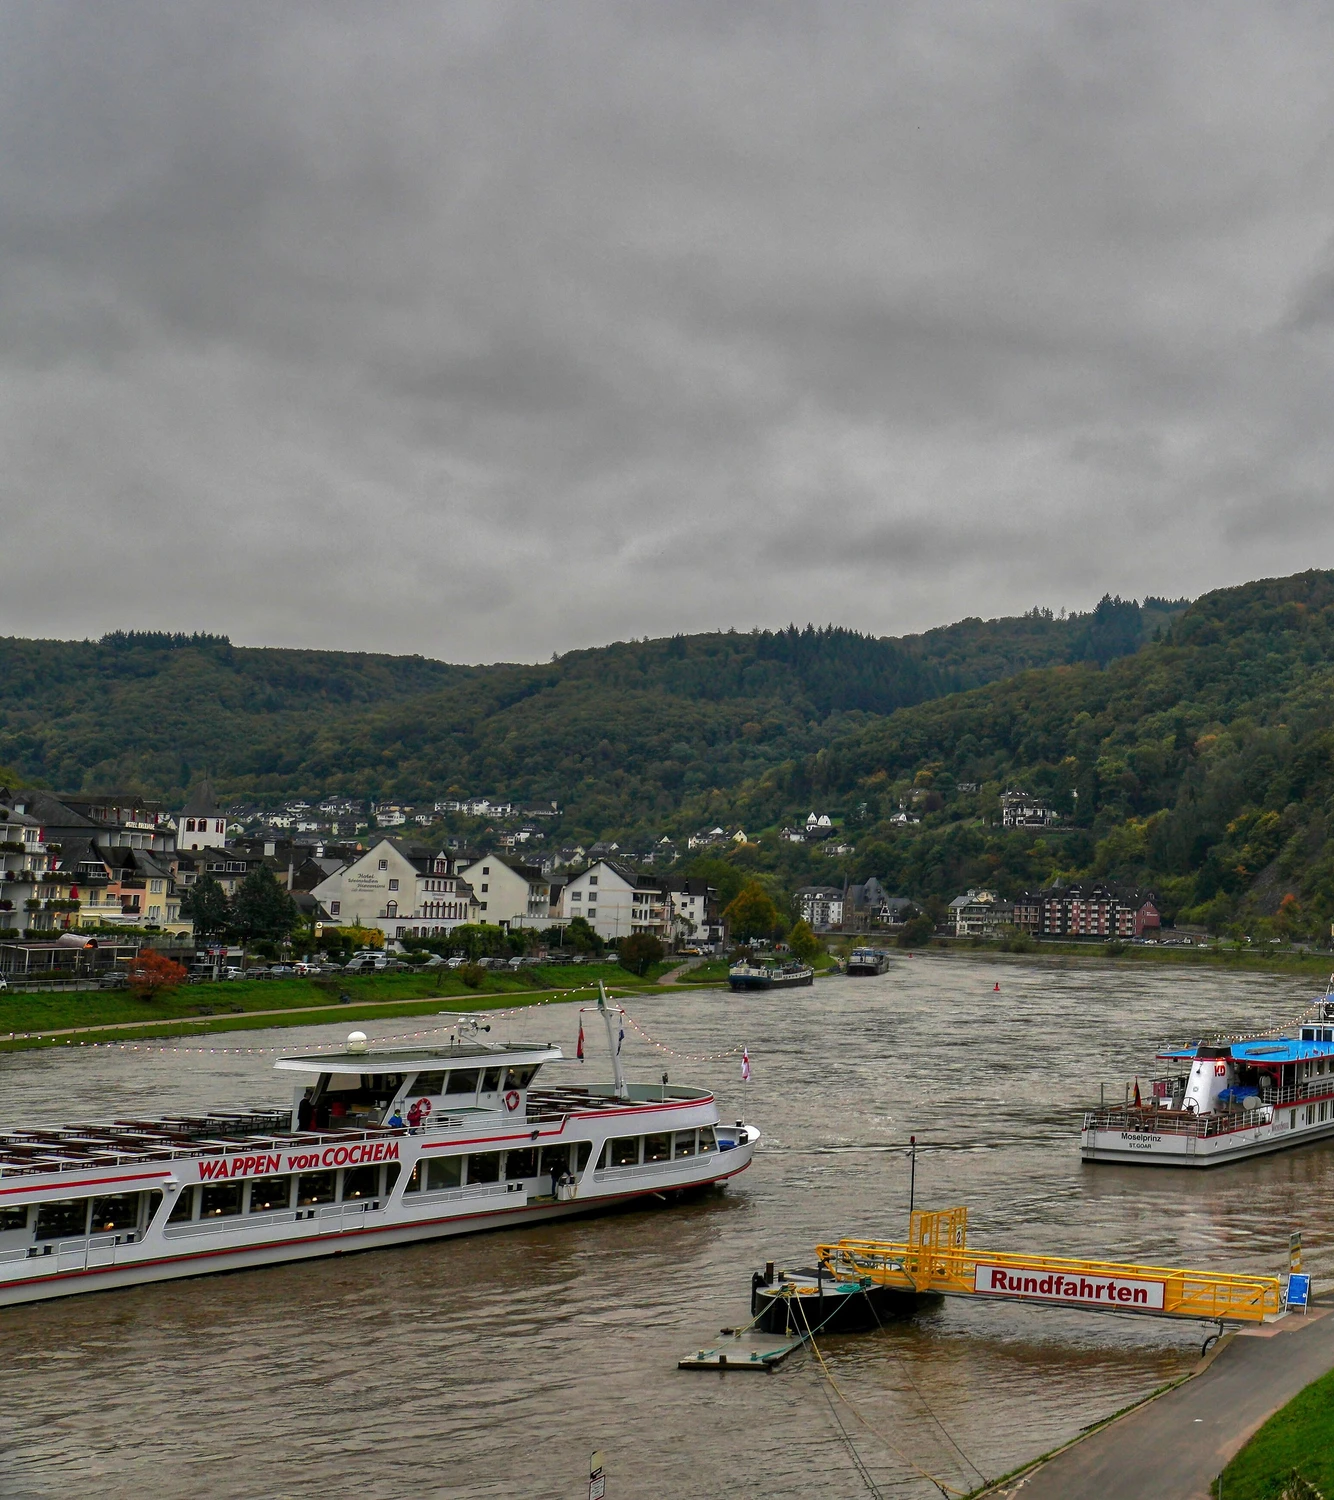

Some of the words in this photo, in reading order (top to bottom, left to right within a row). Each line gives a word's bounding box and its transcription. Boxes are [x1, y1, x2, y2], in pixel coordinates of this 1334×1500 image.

[1214, 1065, 1226, 1077] KD
[1121, 1132, 1161, 1142] Moselprinz
[198, 1153, 282, 1181] WAPPEN
[287, 1153, 320, 1171] von
[321, 1141, 400, 1168] COCHEM
[956, 1231, 961, 1244] 2
[990, 1269, 1149, 1304] Rundfahrten
